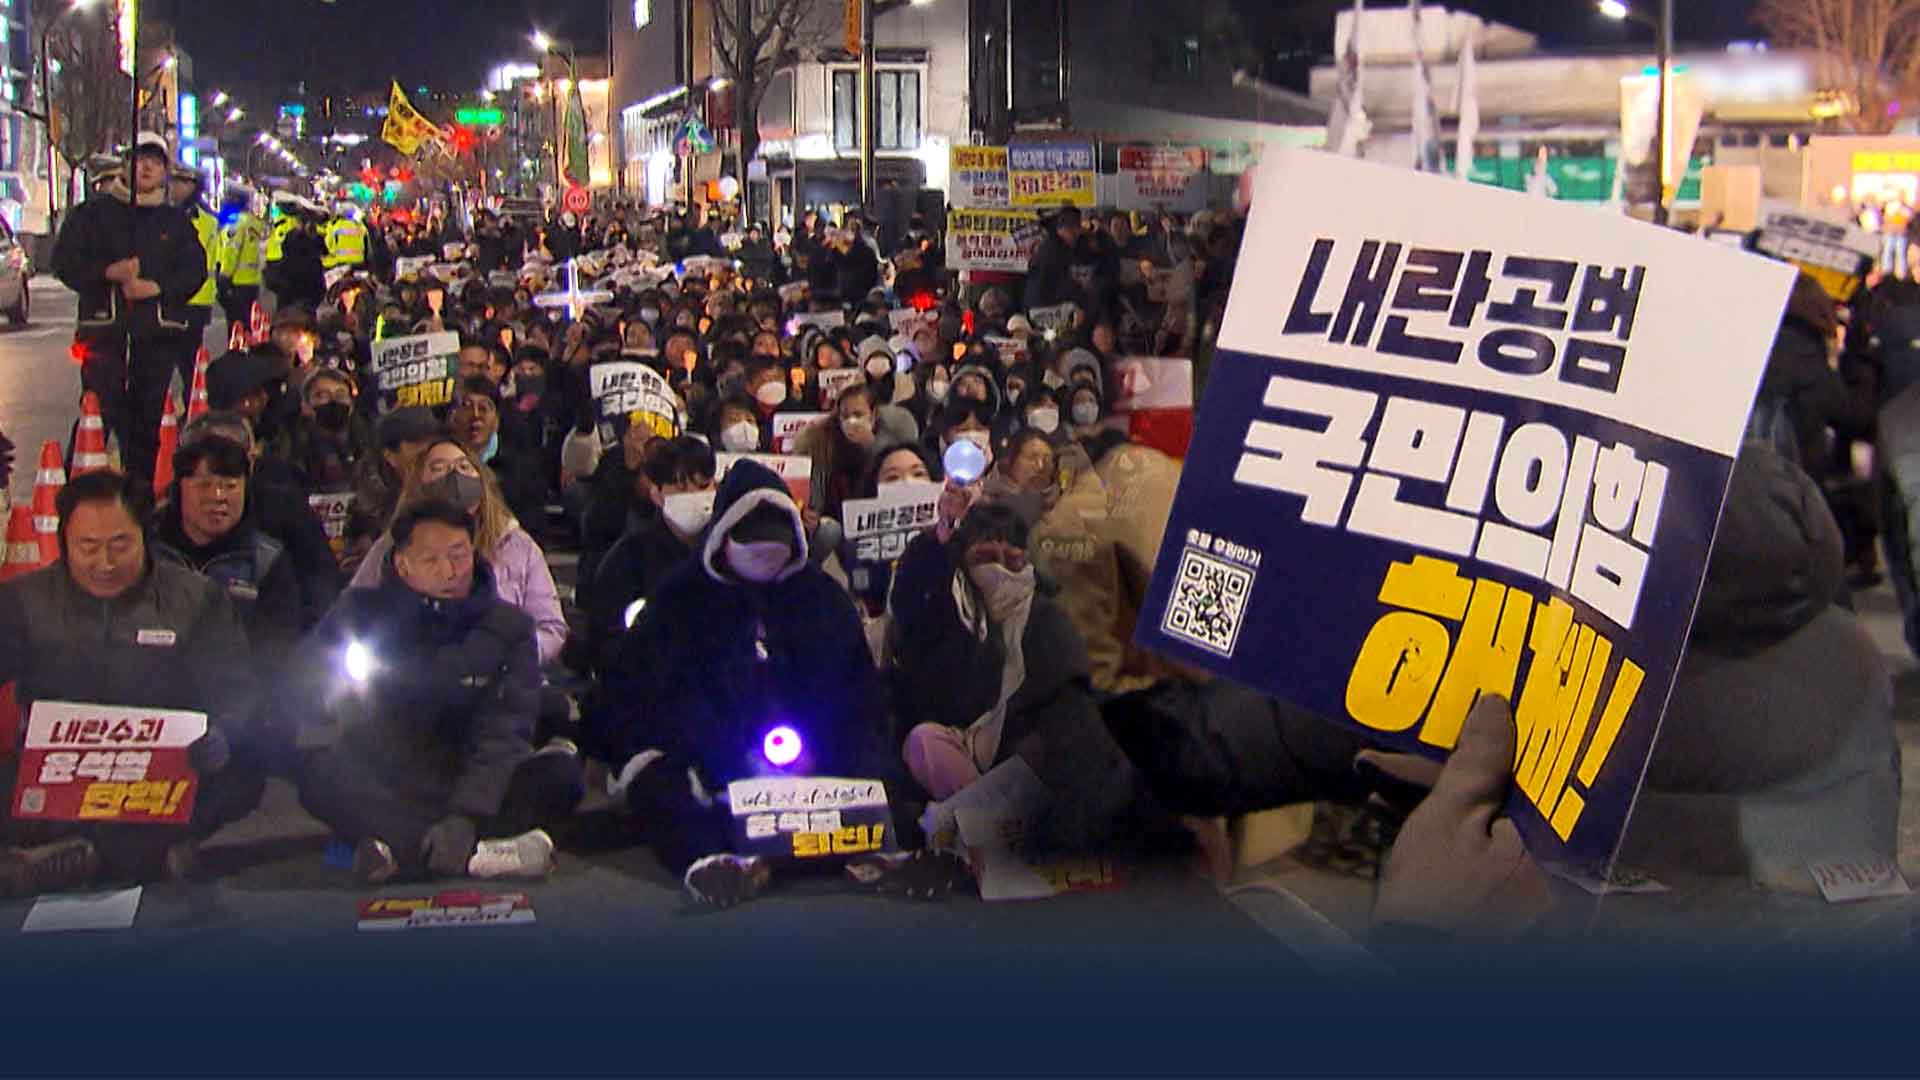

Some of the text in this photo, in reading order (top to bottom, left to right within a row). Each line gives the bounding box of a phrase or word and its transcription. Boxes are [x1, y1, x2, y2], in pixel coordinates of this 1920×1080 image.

[1282, 238, 1646, 394] 내란공범
[856, 502, 935, 531] 내란공범
[1233, 375, 1669, 630] 국민의힘
[856, 530, 921, 560] 국민
[1344, 554, 1646, 843] 해체!
[49, 716, 164, 744] 내란수괴
[38, 751, 152, 784] 윤석열
[79, 779, 190, 817] 탄핵!
[793, 823, 885, 857] 퇴진!
